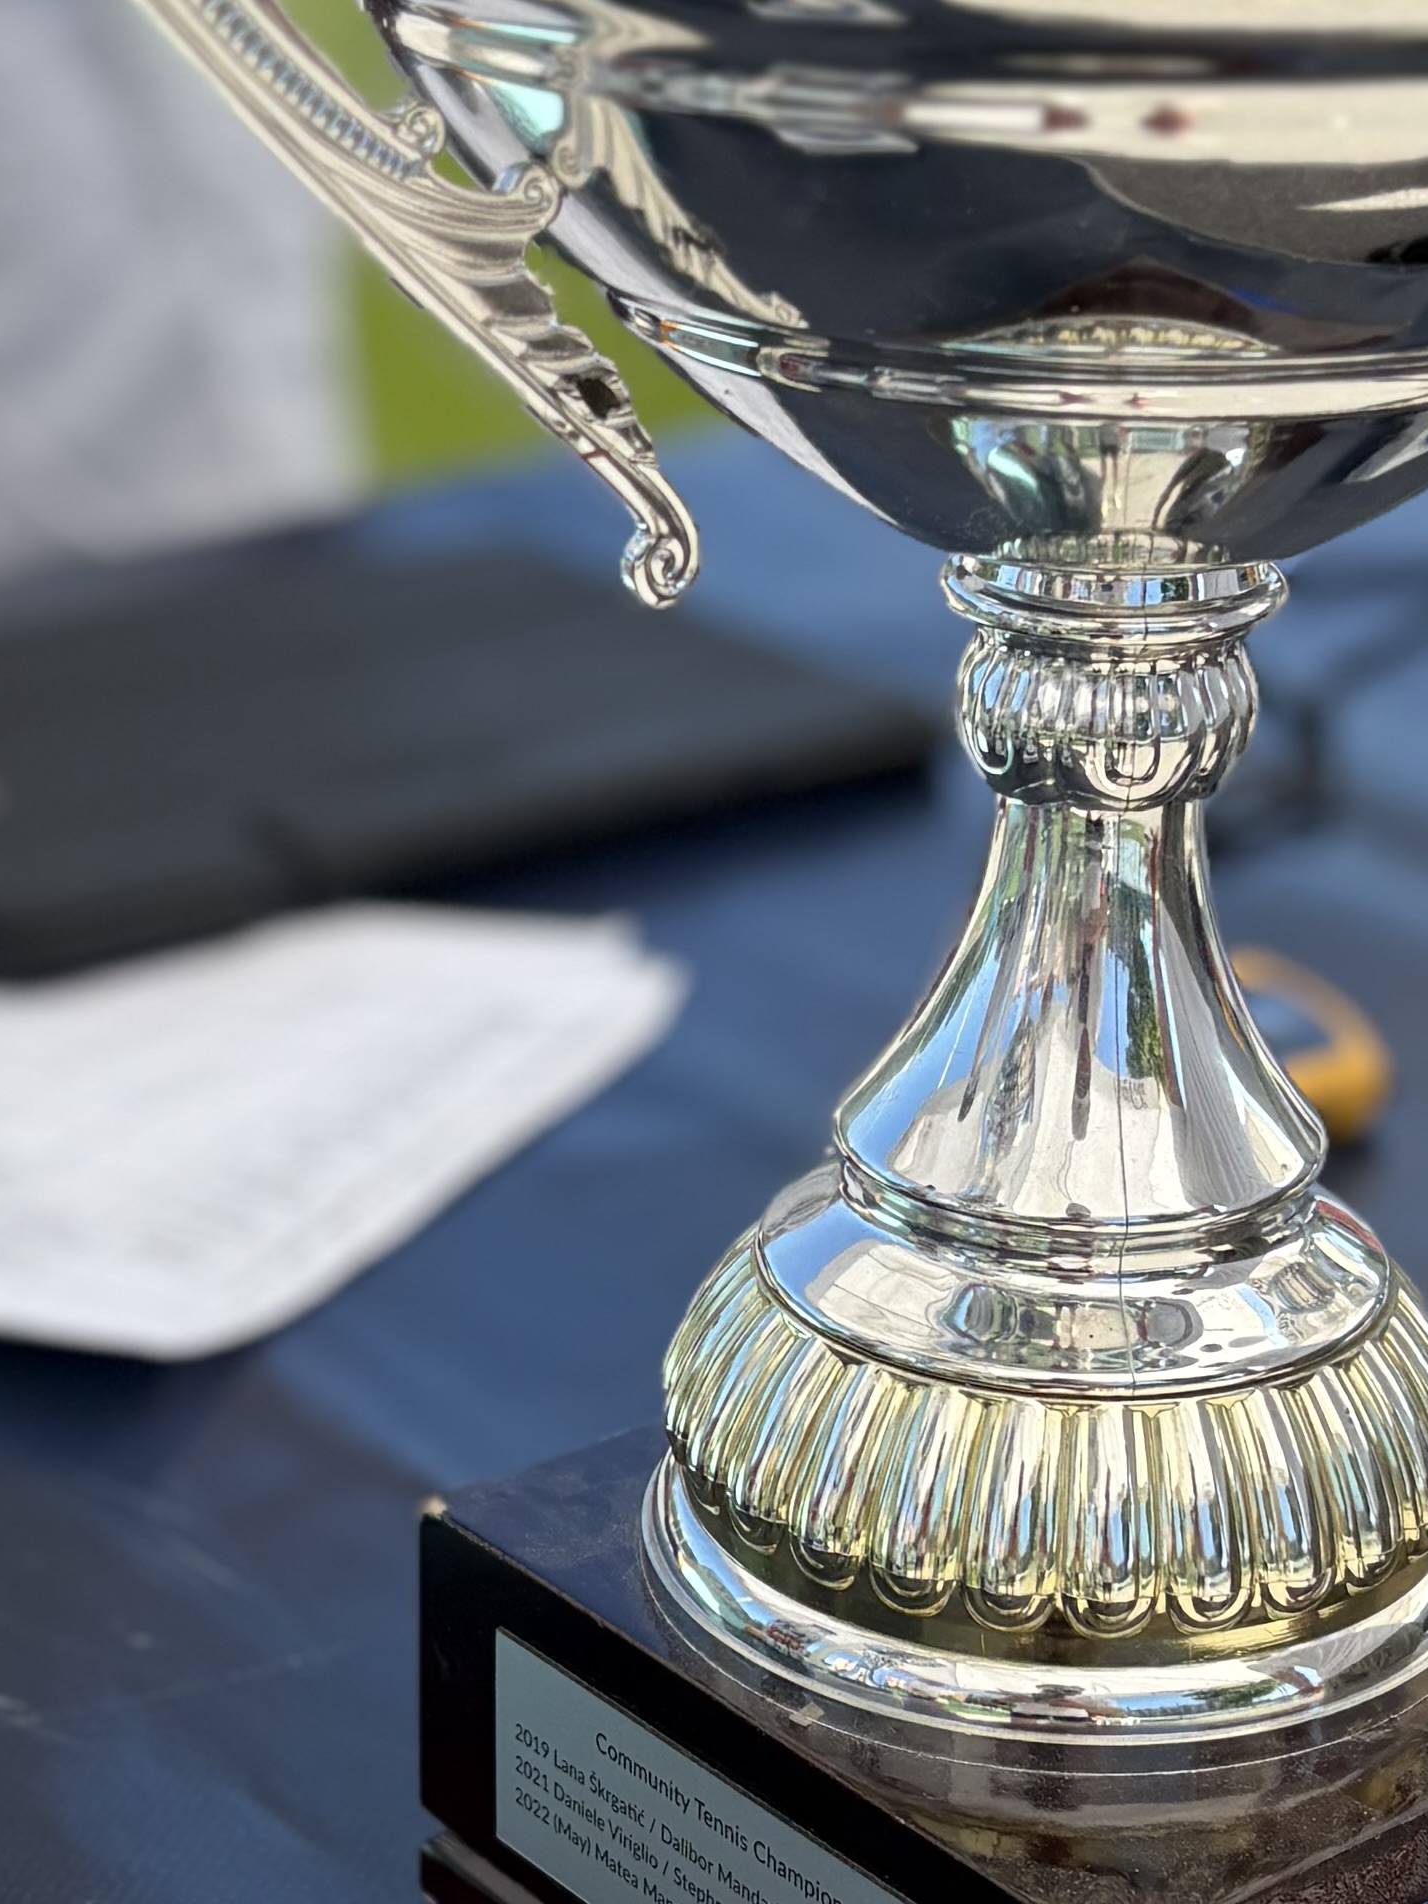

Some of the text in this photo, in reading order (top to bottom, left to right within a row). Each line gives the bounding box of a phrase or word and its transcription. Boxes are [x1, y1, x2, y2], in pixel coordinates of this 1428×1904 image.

[515, 1723, 550, 1758] 2019
[554, 1749, 585, 1786] Lana
[589, 1771, 645, 1828] Škrgatić
[649, 1818, 656, 1834] /
[661, 1823, 714, 1875] Dalibor
[515, 1755, 549, 1793] 2021
[554, 1782, 605, 1831] Daniele
[609, 1819, 658, 1869] Viriglio
[662, 1861, 669, 1875] /
[515, 1787, 550, 1825] 2022
[554, 1813, 591, 1856] (May)
[595, 1844, 639, 1889] Matea
[595, 1732, 690, 1815] Community
[694, 1797, 748, 1852] Tennis
